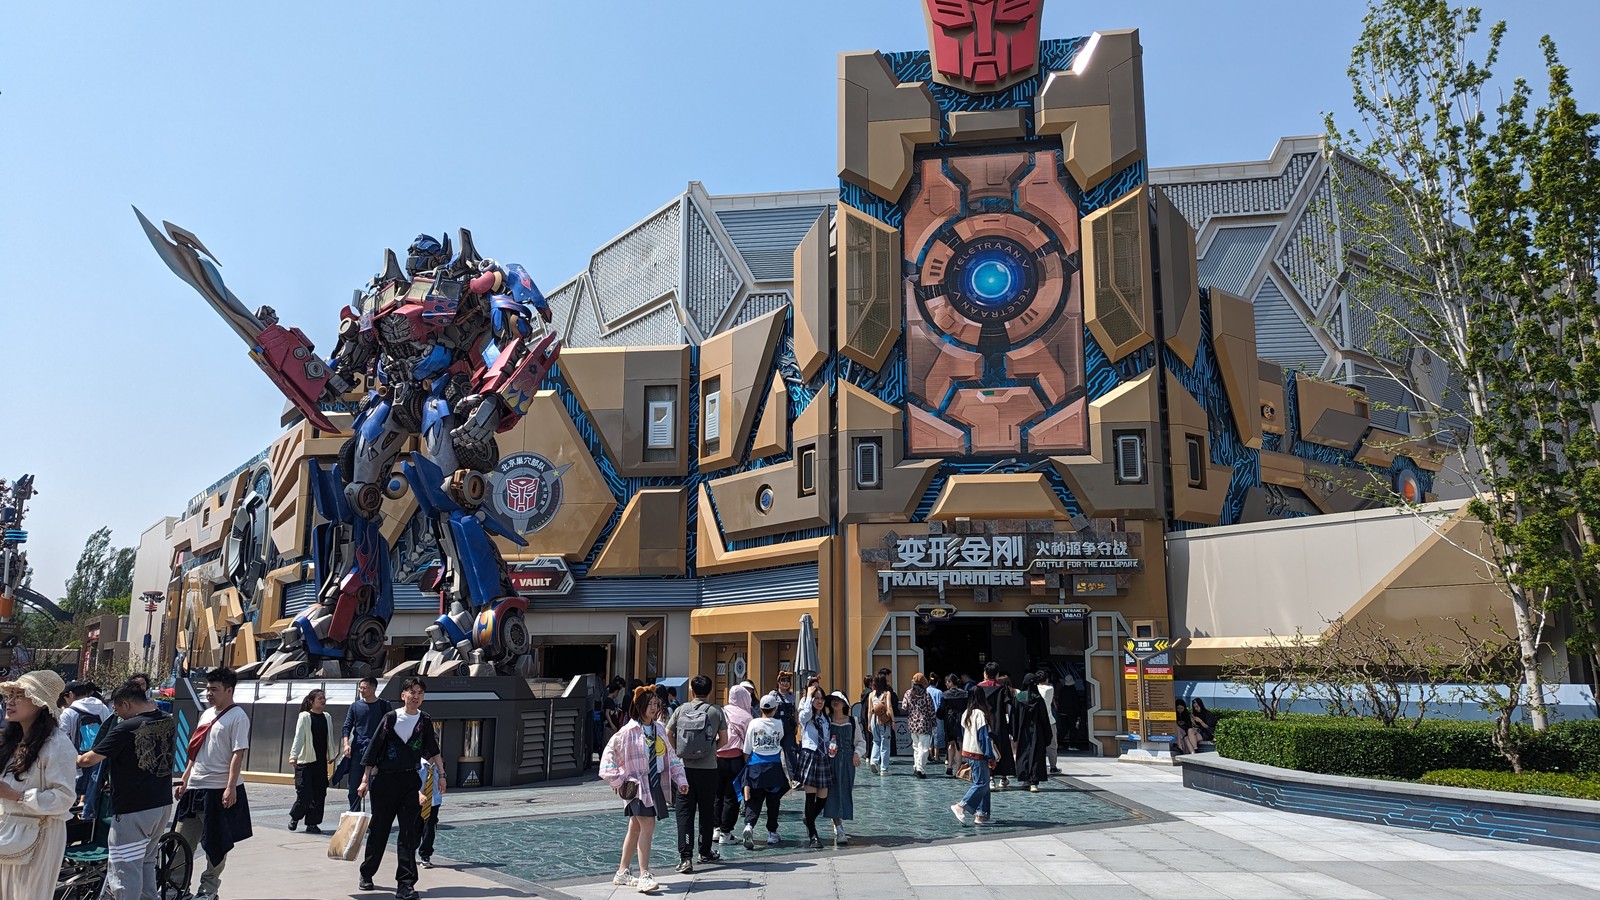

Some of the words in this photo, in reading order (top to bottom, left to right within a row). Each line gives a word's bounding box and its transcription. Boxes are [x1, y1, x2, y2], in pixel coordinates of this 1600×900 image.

[953, 242, 1022, 272] TELETRAAN
[1021, 260, 1030, 269] V
[953, 291, 961, 299] V
[961, 287, 1031, 318] TELETRAAN
[500, 456, 546, 472] 北京巢穴部队
[891, 536, 1024, 568] 变形金刚
[1036, 540, 1128, 557] 火种源争夺战
[1036, 561, 1064, 569] BATTLE
[1067, 561, 1082, 569] FOR
[519, 577, 552, 587] VAULT
[878, 571, 1024, 593] TRANSFORMERS
